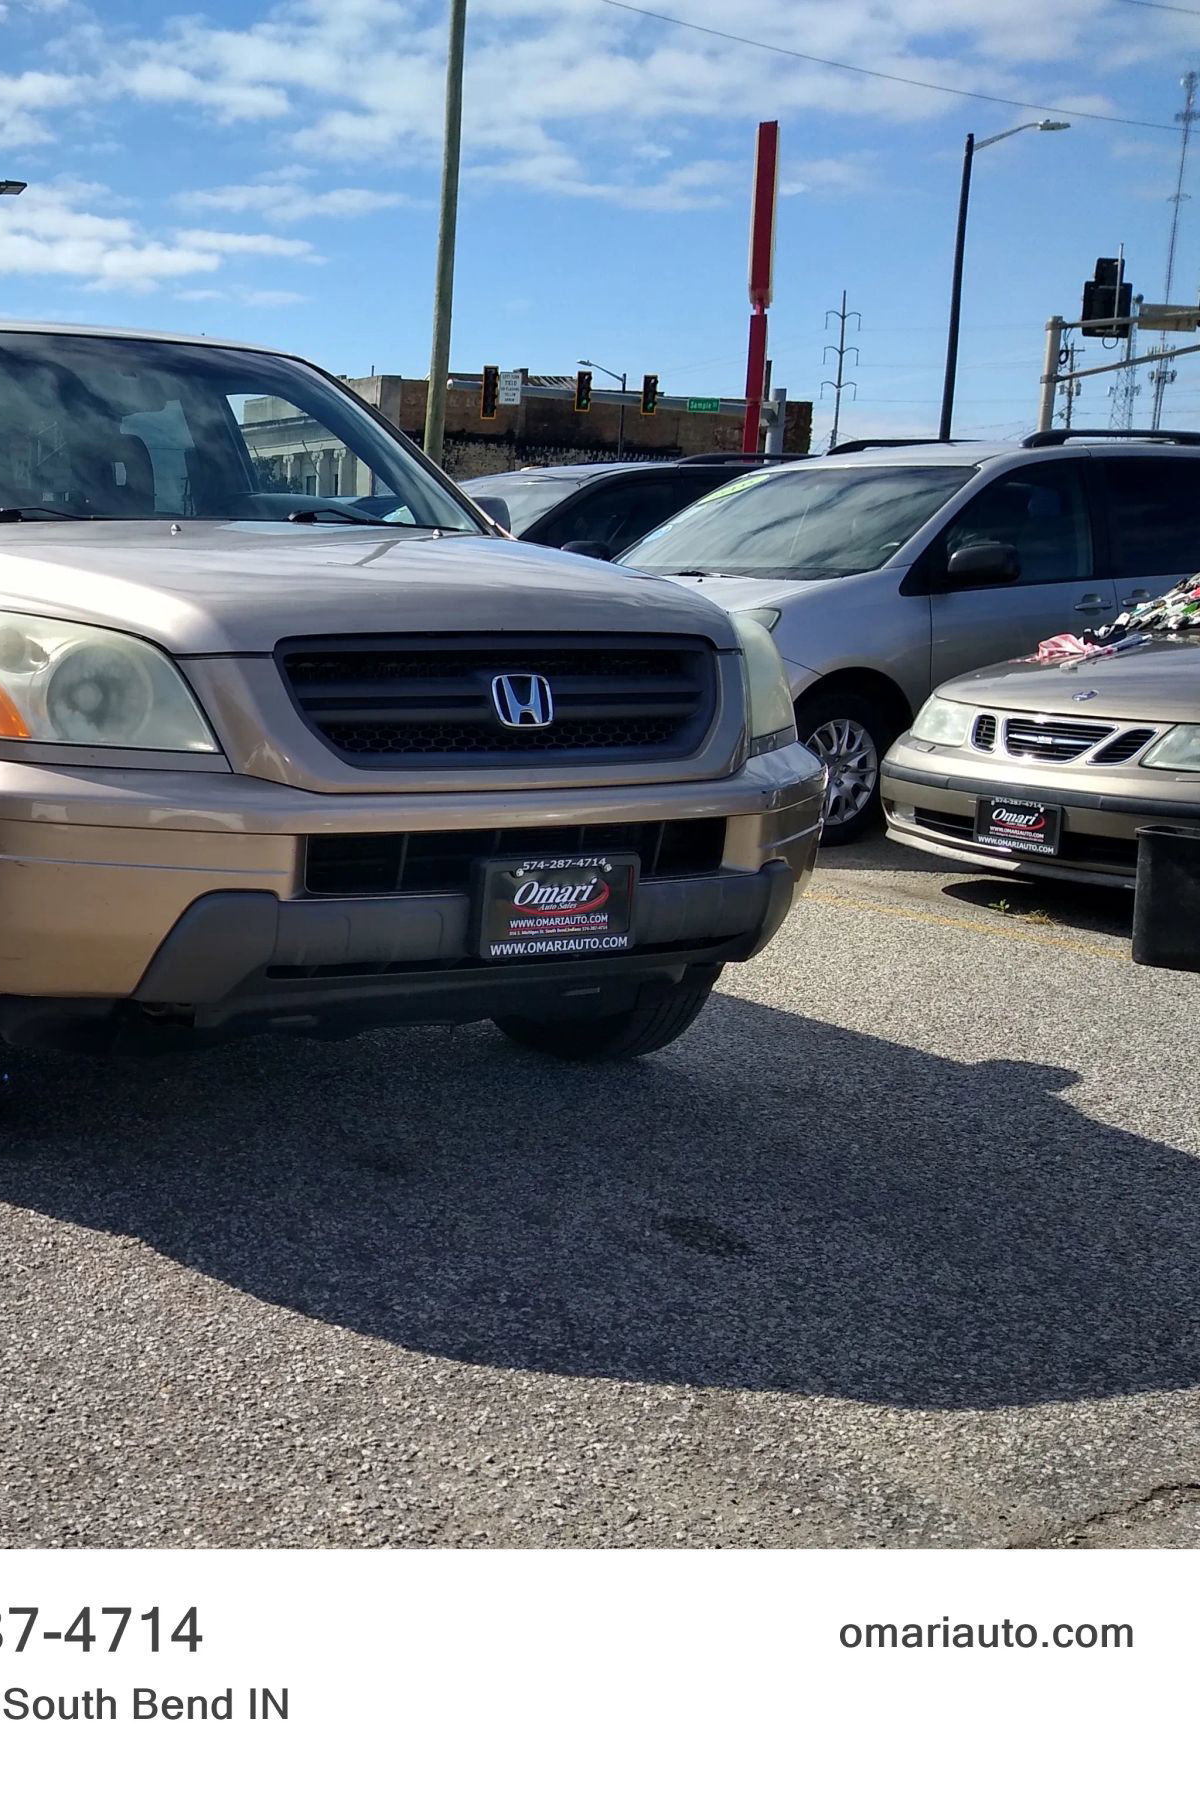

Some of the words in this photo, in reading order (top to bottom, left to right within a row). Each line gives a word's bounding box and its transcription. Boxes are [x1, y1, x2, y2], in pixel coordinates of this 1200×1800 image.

[992, 808, 1038, 825] Omari
[978, 836, 1054, 854] WWW.OMARIAUTO.COM
[523, 857, 607, 870] 574-287-4714
[513, 877, 597, 906] Omari
[510, 915, 608, 928] WWW.OMARIAUTO.COM
[490, 936, 628, 956] WWW.OMARIAUTO.COM
